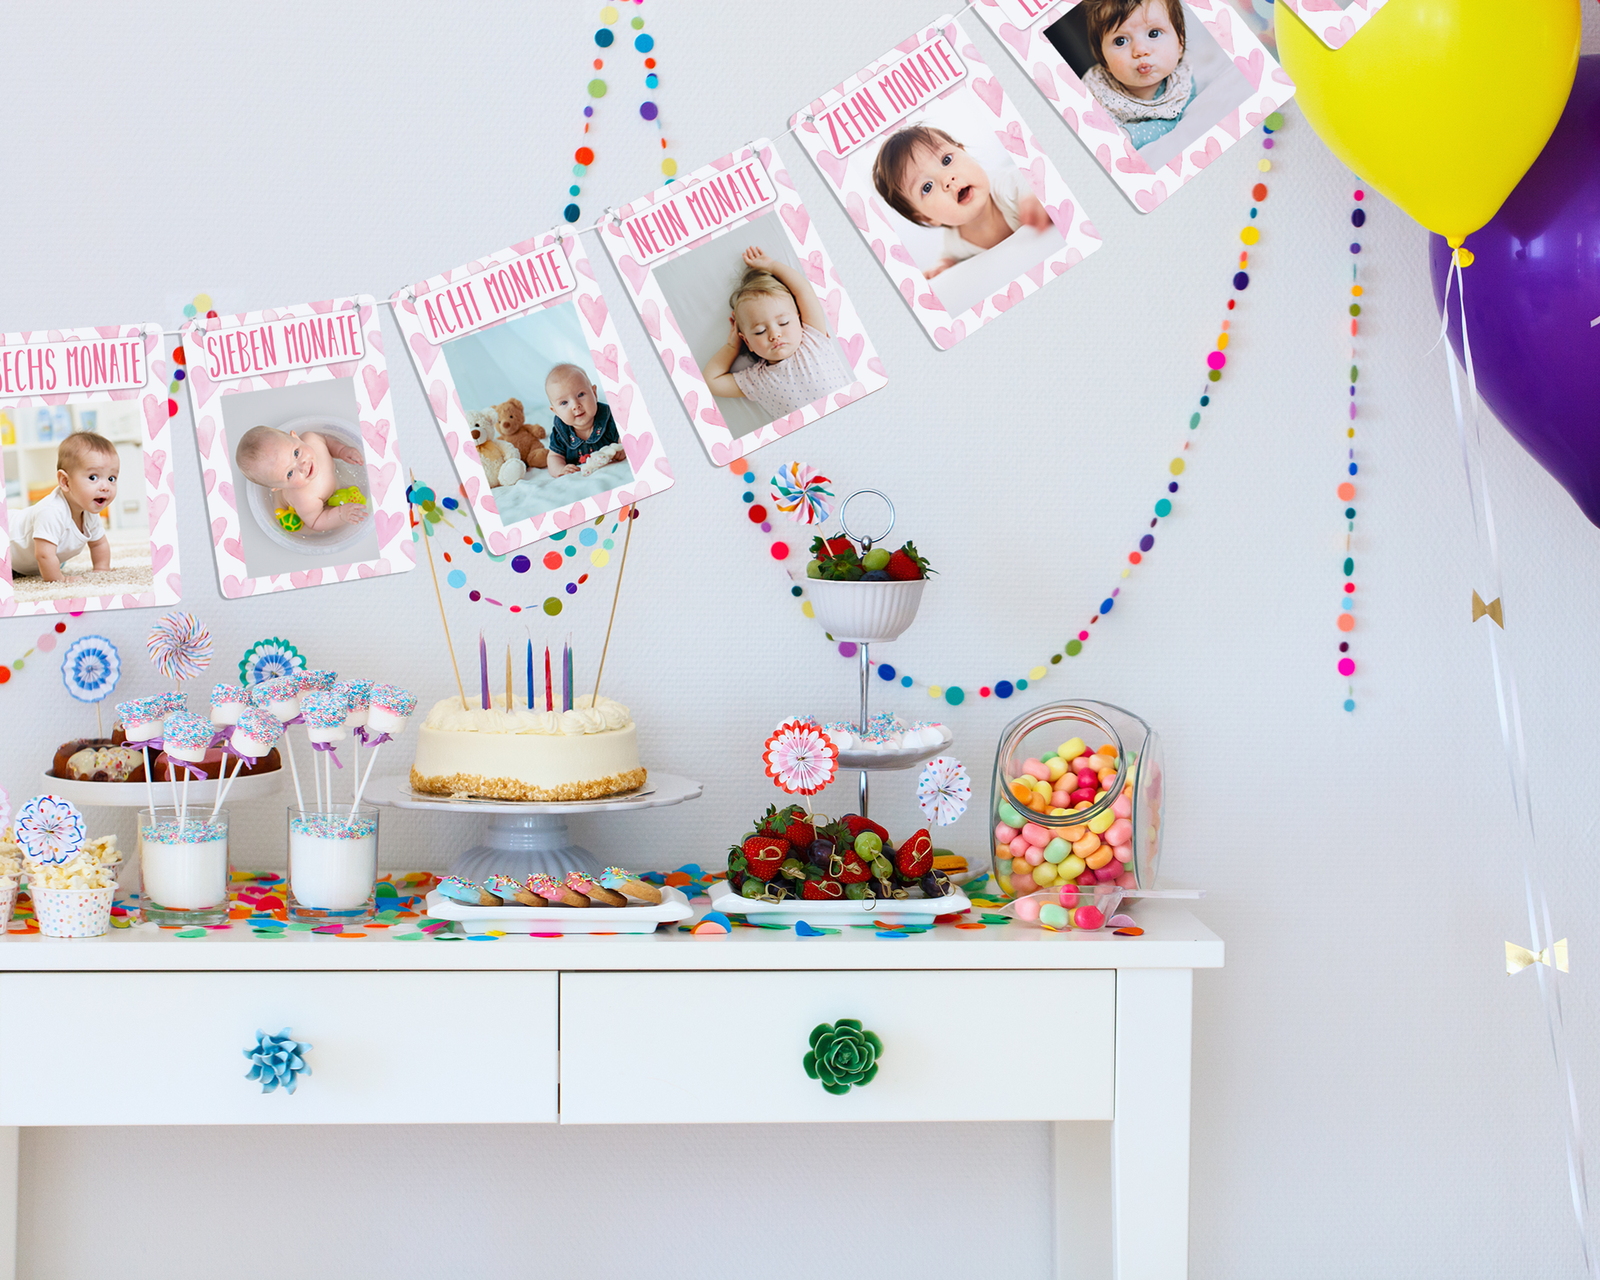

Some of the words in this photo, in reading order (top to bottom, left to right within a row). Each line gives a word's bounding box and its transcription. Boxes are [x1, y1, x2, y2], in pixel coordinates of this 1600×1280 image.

[819, 87, 887, 155] ZEHN
[877, 39, 963, 114] MONATE
[626, 199, 689, 259] NEUN
[685, 162, 770, 231] MONATE
[424, 281, 482, 338] ACHT
[483, 249, 569, 314] MONATE
[0, 348, 57, 393] ECHS
[66, 342, 142, 388] MONATE
[207, 325, 277, 378] SIEBEN
[283, 314, 361, 364] MONATE
